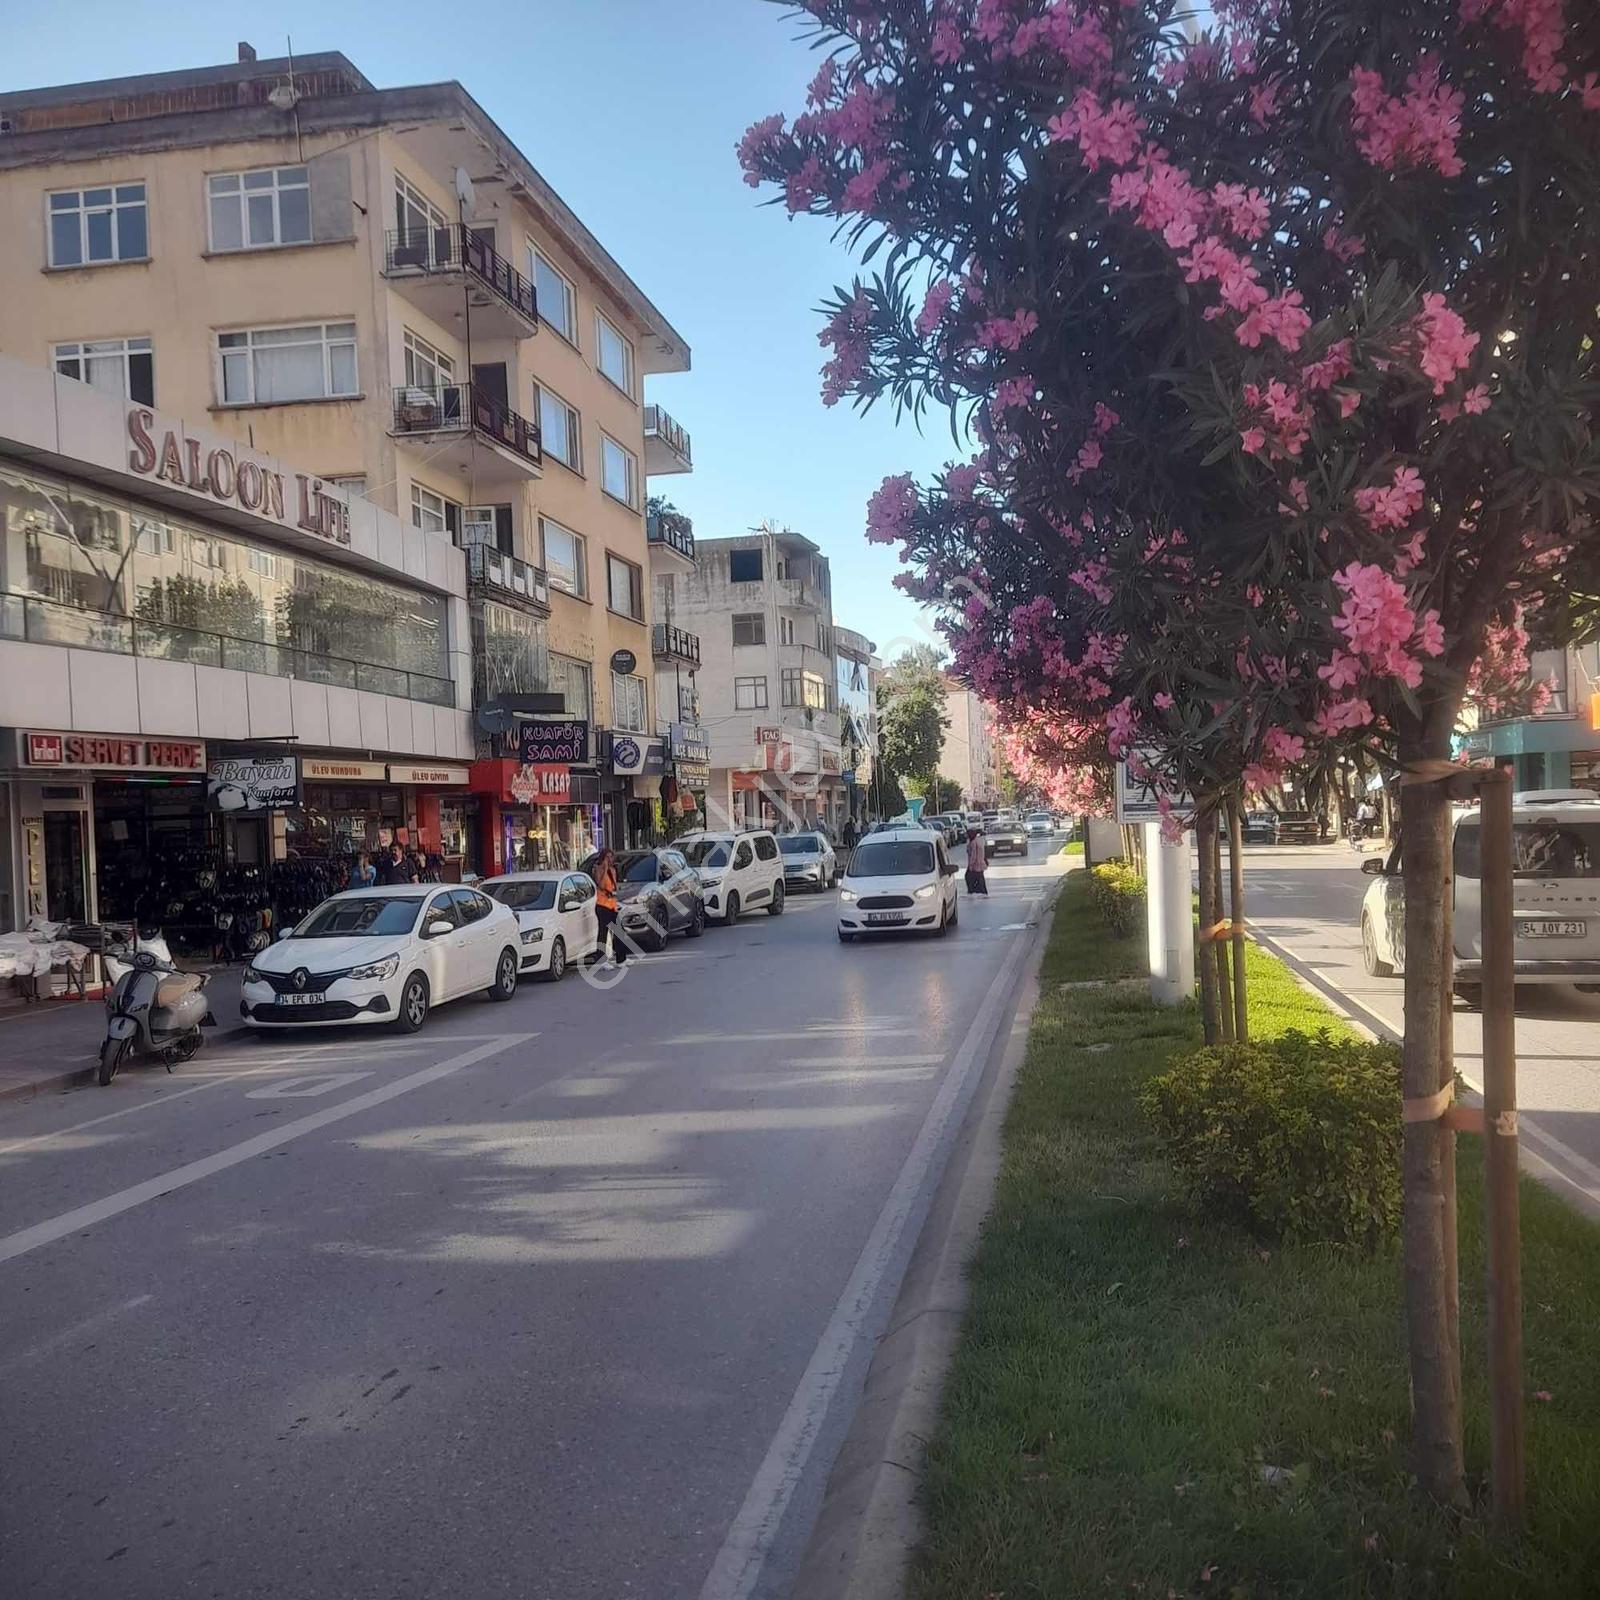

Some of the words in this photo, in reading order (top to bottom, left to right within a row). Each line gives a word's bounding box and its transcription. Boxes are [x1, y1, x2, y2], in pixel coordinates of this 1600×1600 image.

[523, 722, 585, 741] KUAFÖR
[65, 736, 143, 765] SERVET
[146, 741, 203, 768] PERDE
[211, 761, 292, 788] Bayan
[542, 771, 571, 793] KASAP
[1523, 922, 1536, 933] 54
[1564, 923, 1583, 934] 231
